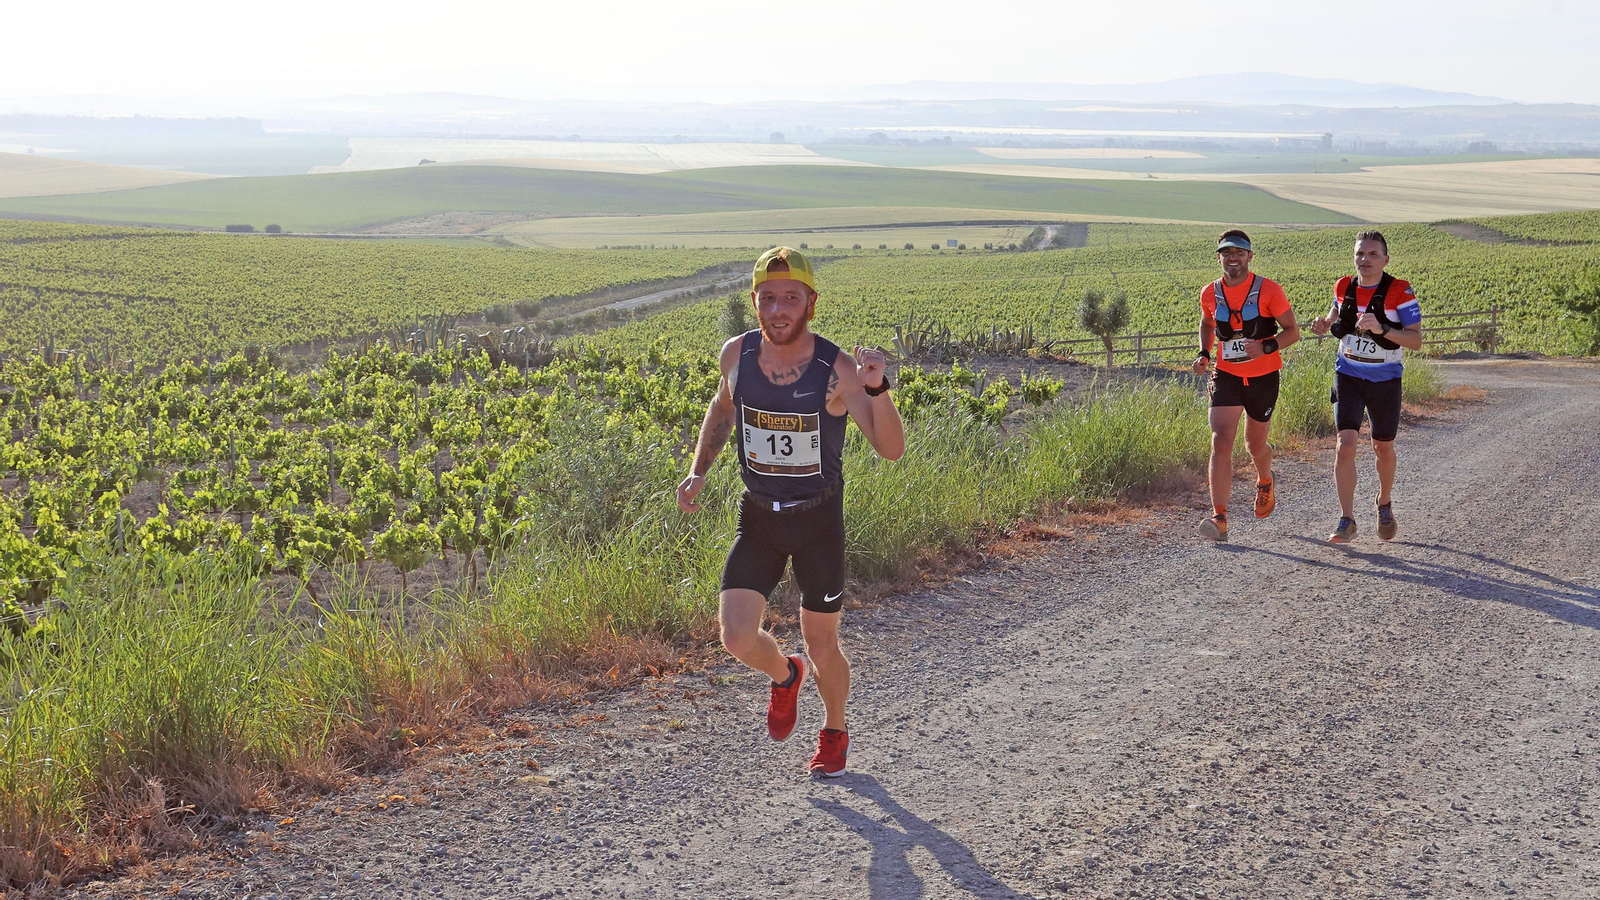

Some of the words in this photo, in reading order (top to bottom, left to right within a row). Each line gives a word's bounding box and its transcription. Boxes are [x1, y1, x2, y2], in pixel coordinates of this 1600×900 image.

[1355, 337, 1377, 354] 173
[761, 413, 799, 430] Sherry
[766, 433, 794, 457] 13
